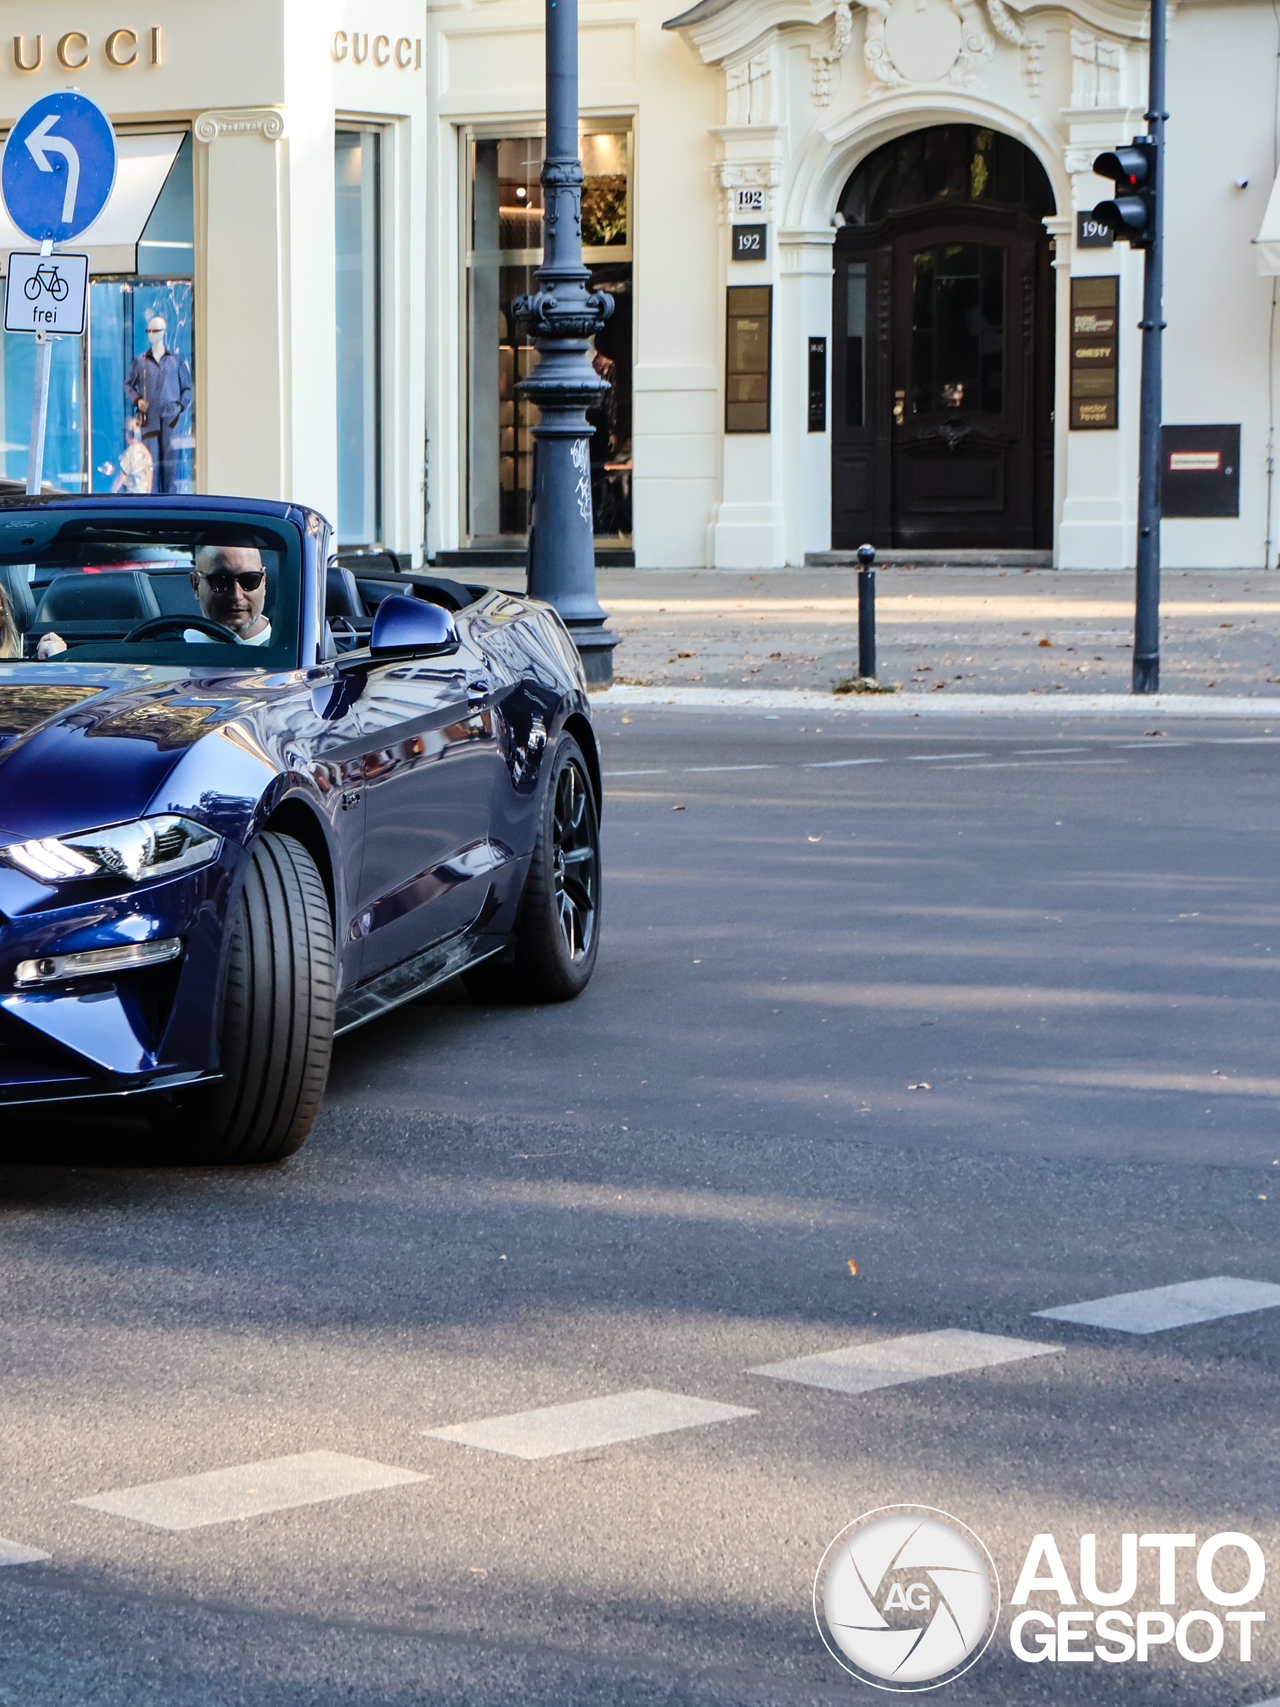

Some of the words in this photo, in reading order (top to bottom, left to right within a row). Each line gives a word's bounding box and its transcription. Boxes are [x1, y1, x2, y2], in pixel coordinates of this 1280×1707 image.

[329, 30, 422, 71] GUCCI
[738, 191, 762, 206] 192
[738, 234, 760, 250] 192
[33, 306, 57, 323] frei
